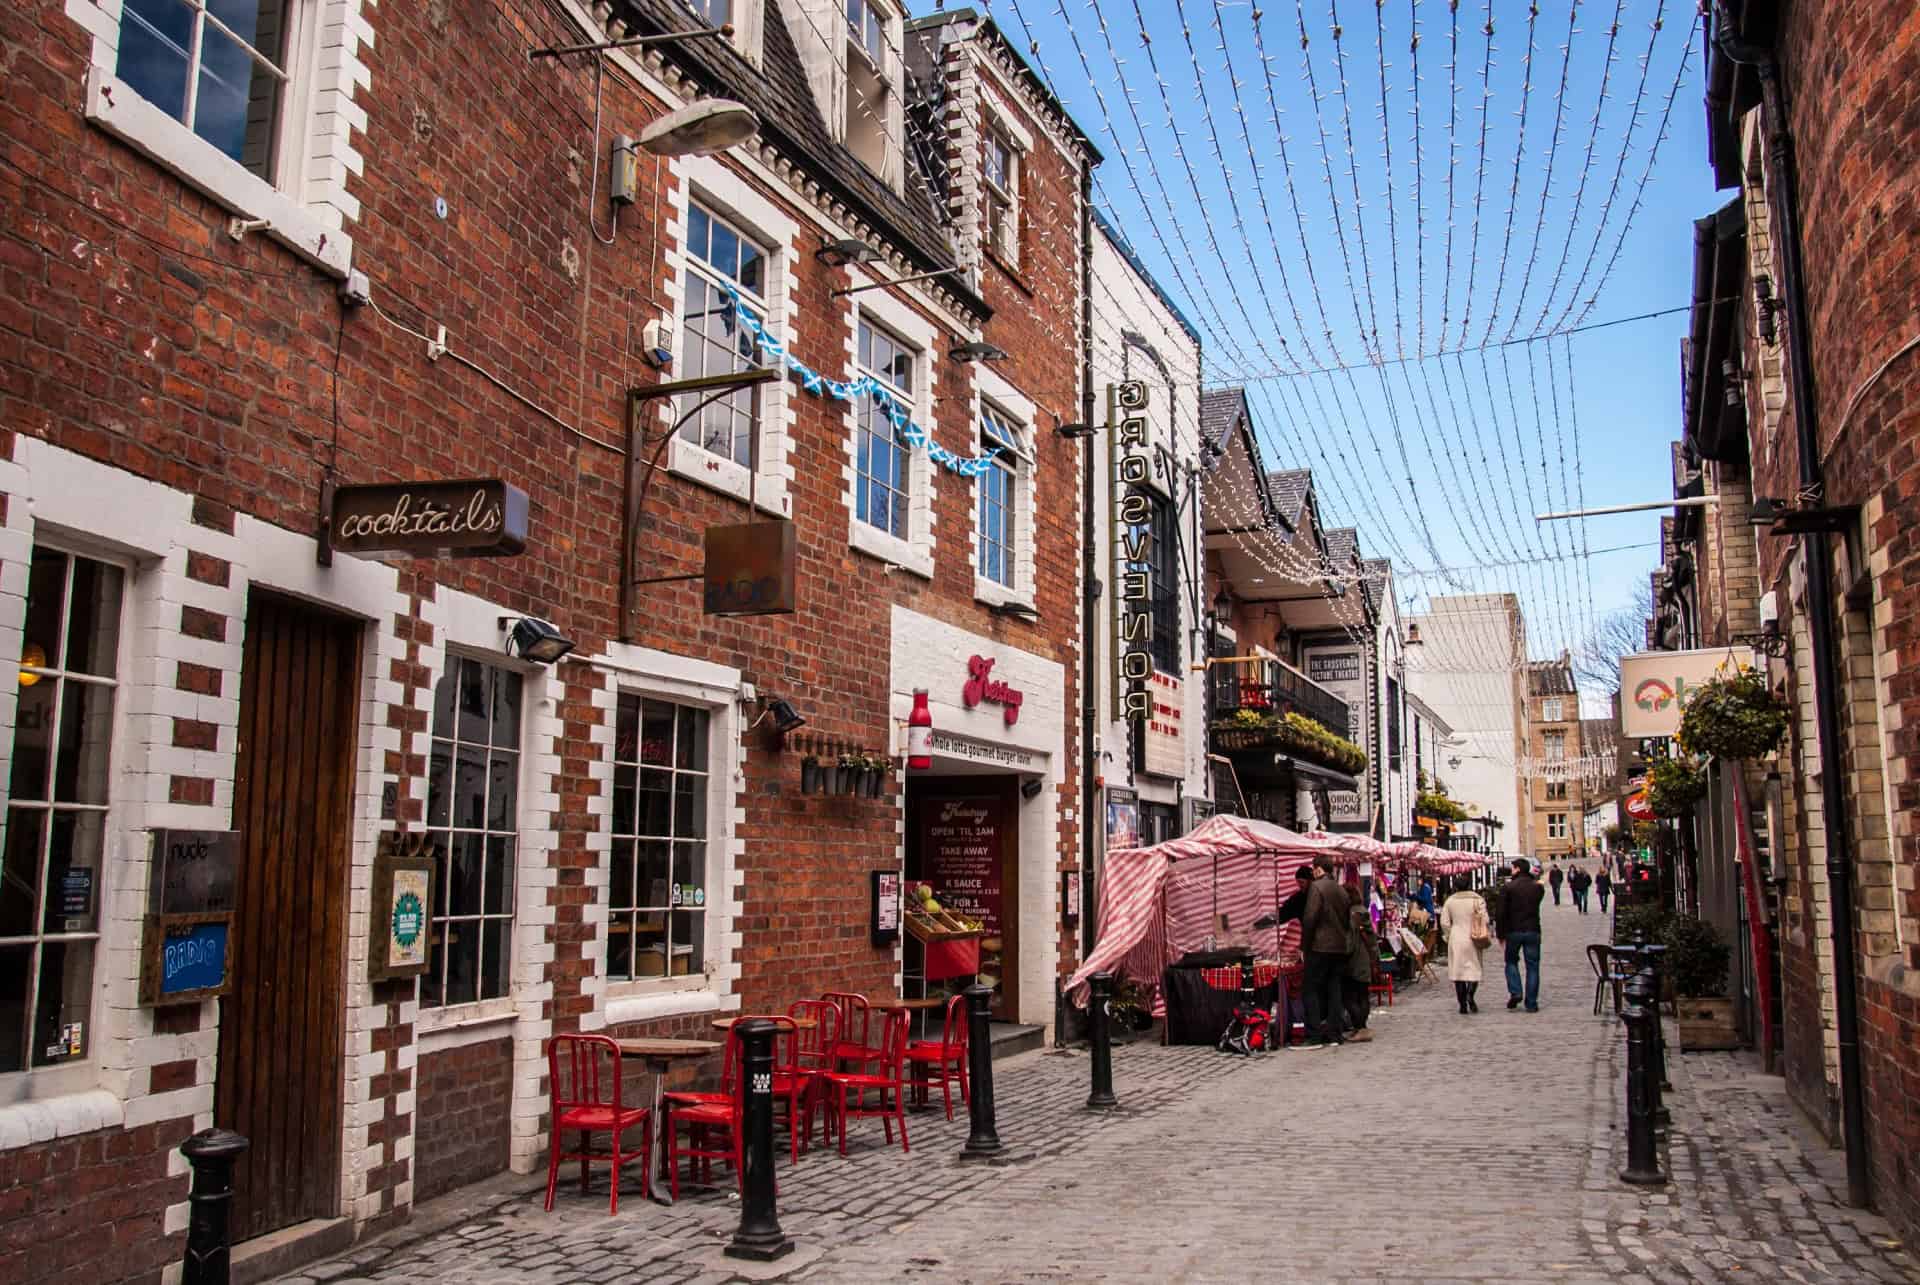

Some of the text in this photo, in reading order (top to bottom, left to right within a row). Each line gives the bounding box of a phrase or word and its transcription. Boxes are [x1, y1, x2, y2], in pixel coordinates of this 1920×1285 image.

[341, 488, 501, 537] cocktails
[952, 738, 967, 754] lotta
[996, 746, 1017, 765] burger
[931, 827, 955, 836] OPEN
[941, 847, 989, 856] TAKE AWAY
[954, 879, 982, 888] SAUCE
[954, 898, 971, 908] FOR
